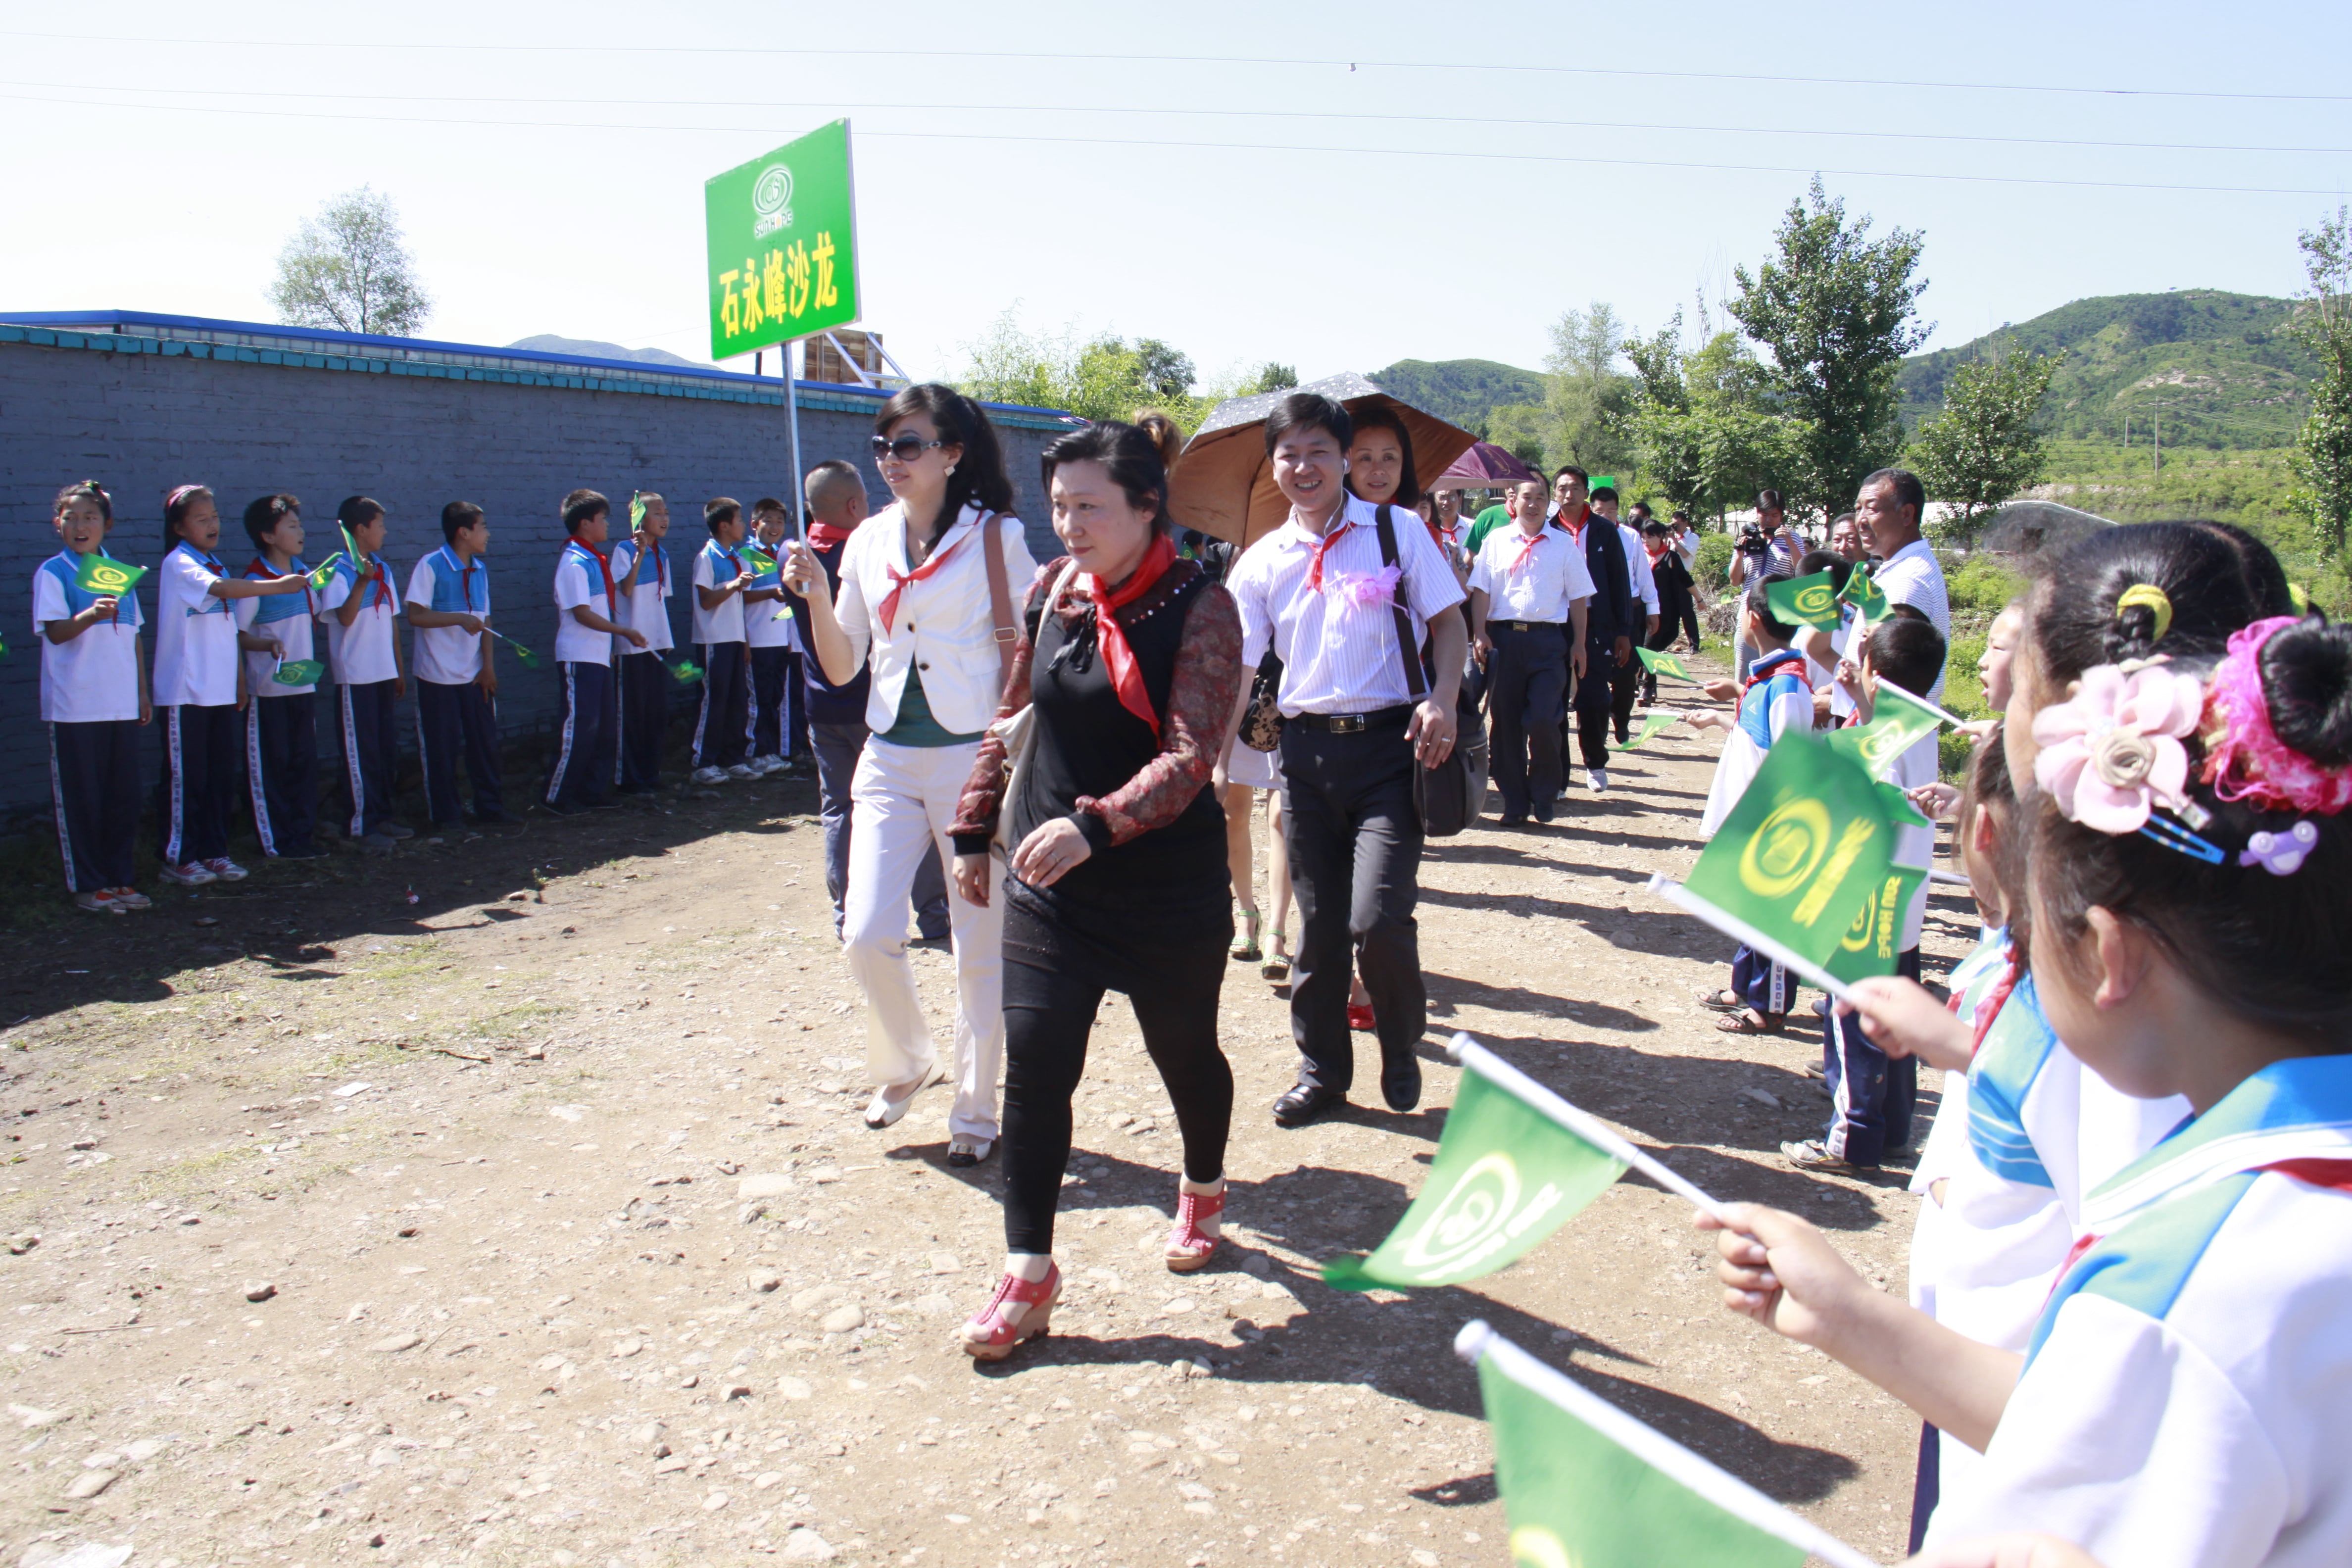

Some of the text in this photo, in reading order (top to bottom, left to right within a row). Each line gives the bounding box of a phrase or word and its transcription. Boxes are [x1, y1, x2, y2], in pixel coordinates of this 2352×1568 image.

[755, 210, 792, 237] SUN HOPE
[719, 231, 837, 339] 石永峰沙龙
